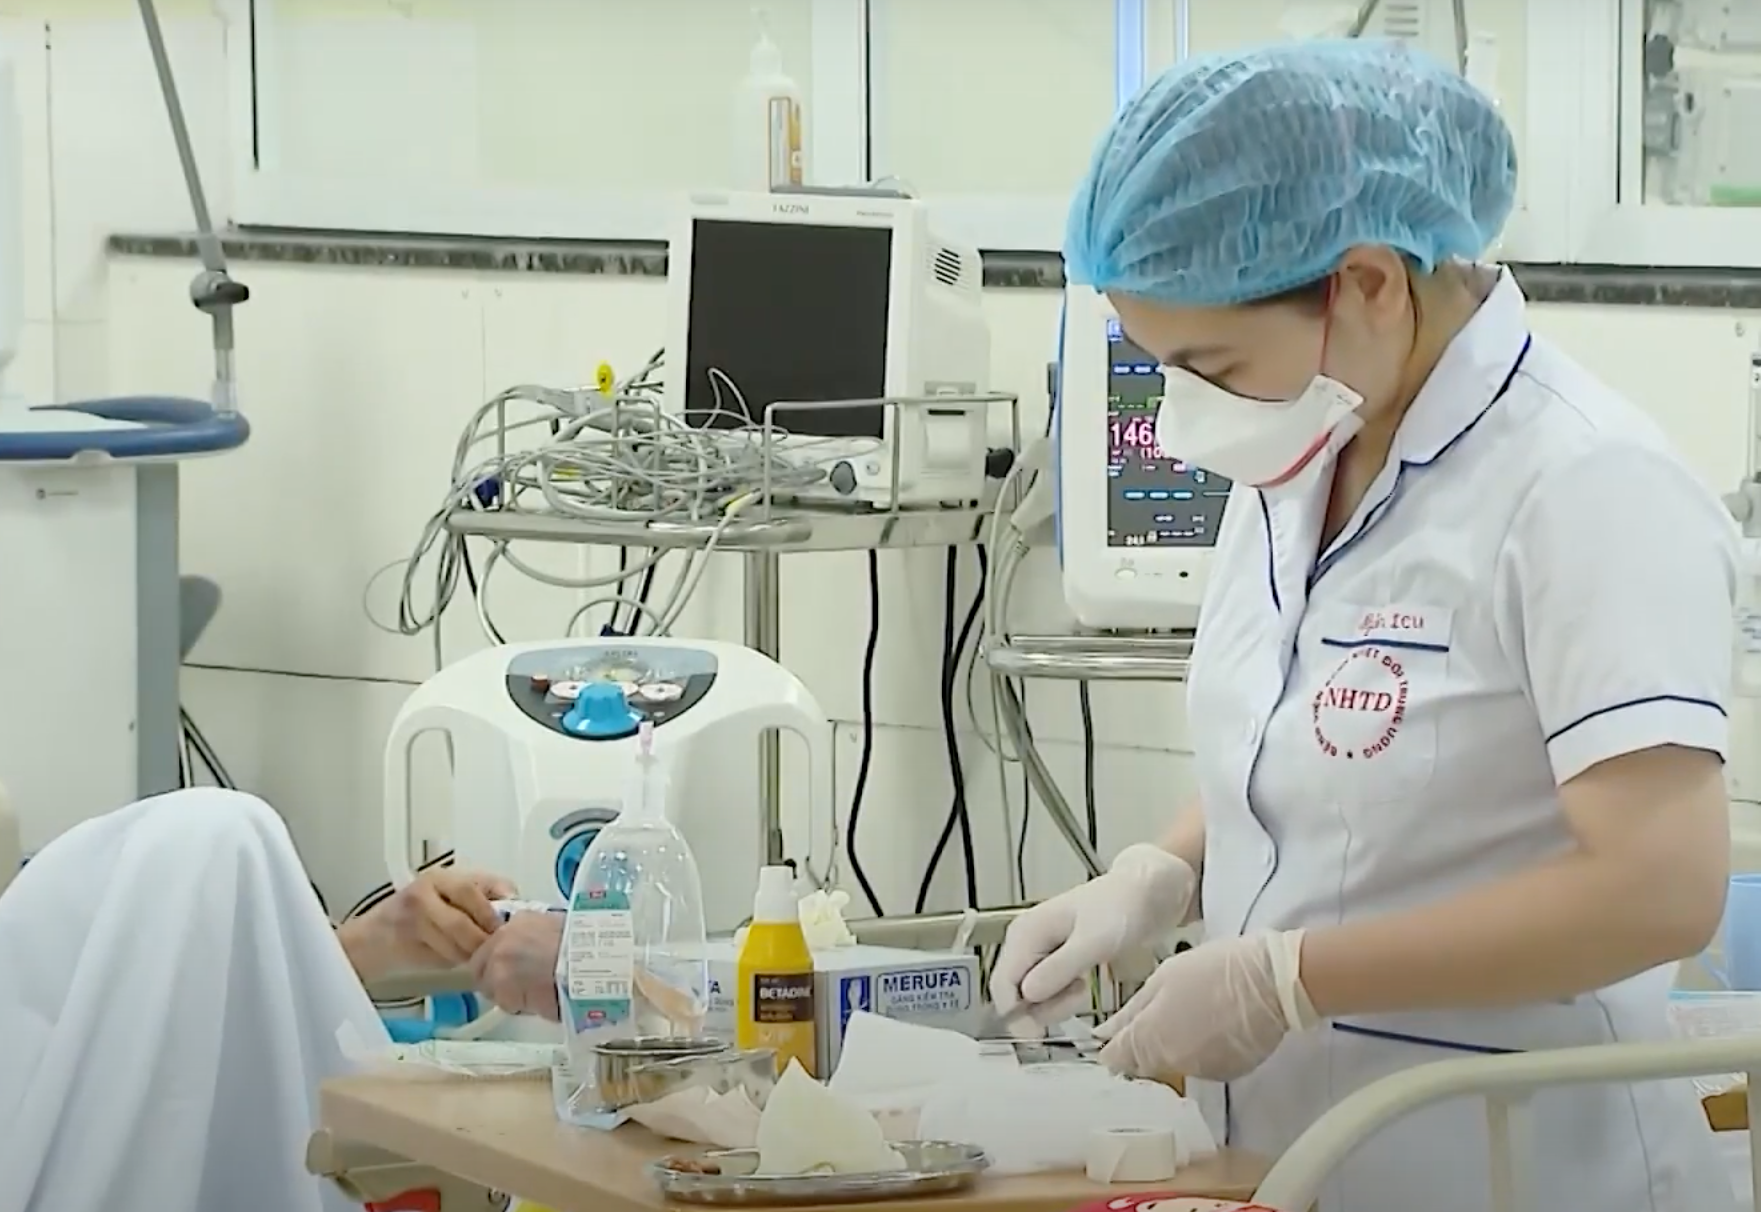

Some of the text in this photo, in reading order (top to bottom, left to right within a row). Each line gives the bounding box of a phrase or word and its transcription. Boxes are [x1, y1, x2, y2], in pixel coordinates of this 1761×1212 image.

[1111, 422, 1154, 447] 146
[1390, 613, 1424, 629] ICU
[1323, 687, 1393, 712] NHTD
[883, 971, 961, 993] MERUFA
